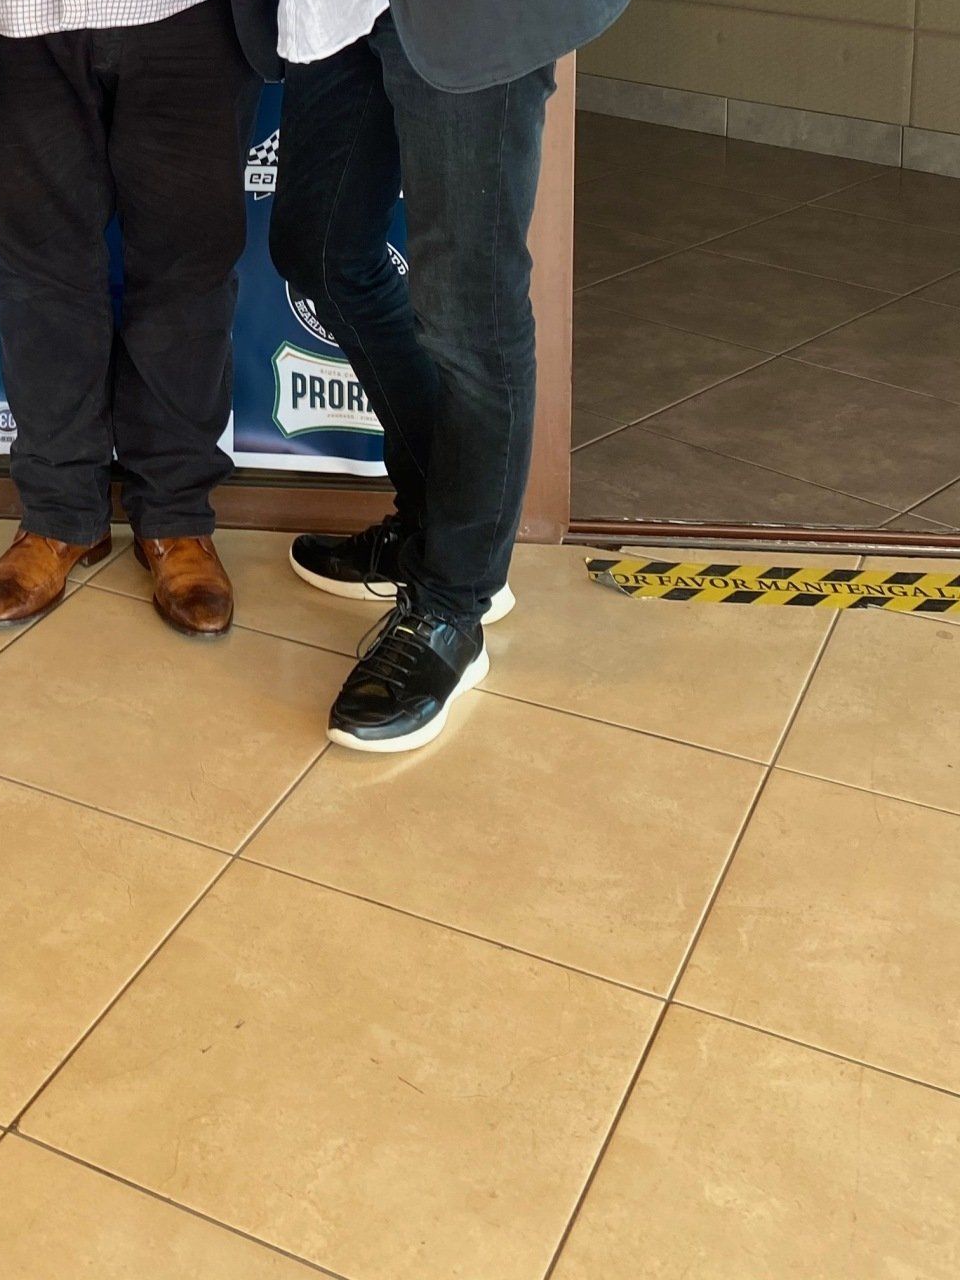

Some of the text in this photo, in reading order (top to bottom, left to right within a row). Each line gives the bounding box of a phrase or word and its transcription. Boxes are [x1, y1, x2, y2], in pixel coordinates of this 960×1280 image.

[613, 573, 960, 599] OR FAVOR MANTENGA L
